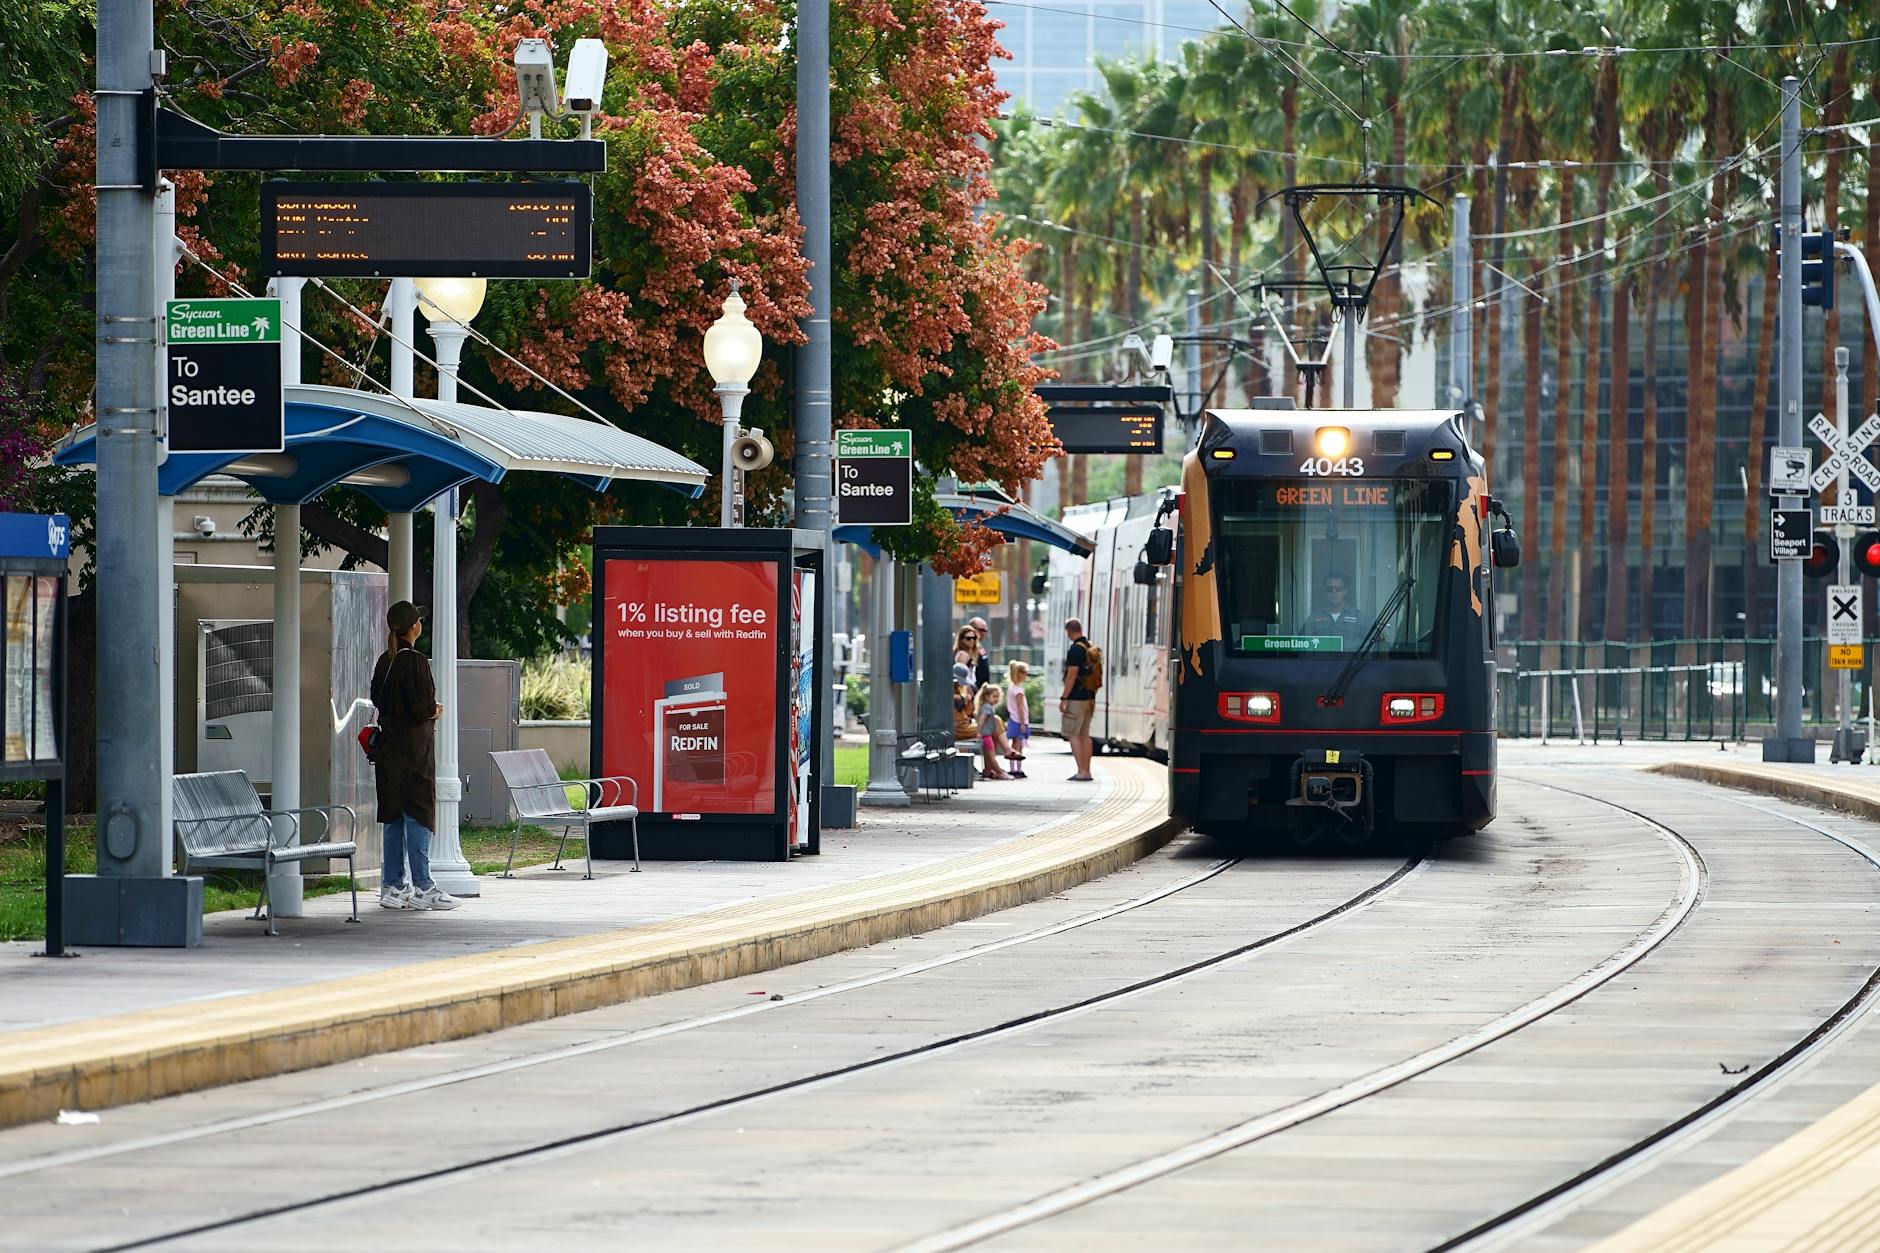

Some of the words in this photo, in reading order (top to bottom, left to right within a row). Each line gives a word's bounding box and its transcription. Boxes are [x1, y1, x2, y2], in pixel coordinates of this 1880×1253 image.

[171, 304, 222, 323] Sycuan
[171, 323, 215, 338] Green
[217, 323, 250, 337] Line
[171, 356, 199, 377] To
[171, 385, 256, 406] Santee
[841, 432, 873, 445] Sycuan
[840, 444, 868, 455] Green
[869, 444, 891, 455] Line
[840, 465, 859, 479] To
[1300, 457, 1365, 477] 4043
[840, 482, 894, 497] Santee
[1276, 487, 1332, 505] GREEN
[1343, 487, 1389, 505] LINE
[1844, 493, 1853, 507] 3
[1823, 508, 1873, 522] TRACKS
[1774, 530, 1785, 538] To
[1774, 538, 1806, 548] Seaport
[1774, 547, 1798, 556] Village
[617, 602, 647, 622] 1%
[655, 603, 723, 628] listing
[730, 603, 766, 624] fee
[618, 629, 644, 638] when
[646, 630, 664, 640] you
[666, 629, 684, 640] buy
[686, 629, 693, 638] &
[695, 629, 711, 638] sell
[713, 630, 734, 639] with
[736, 630, 767, 639] Redfin
[1264, 639, 1290, 648] Green
[1291, 639, 1310, 648] Line
[1840, 648, 1851, 656] NO
[683, 682, 700, 691] SOLD
[692, 722, 709, 730] SALE
[671, 736, 718, 751] REDFIN
